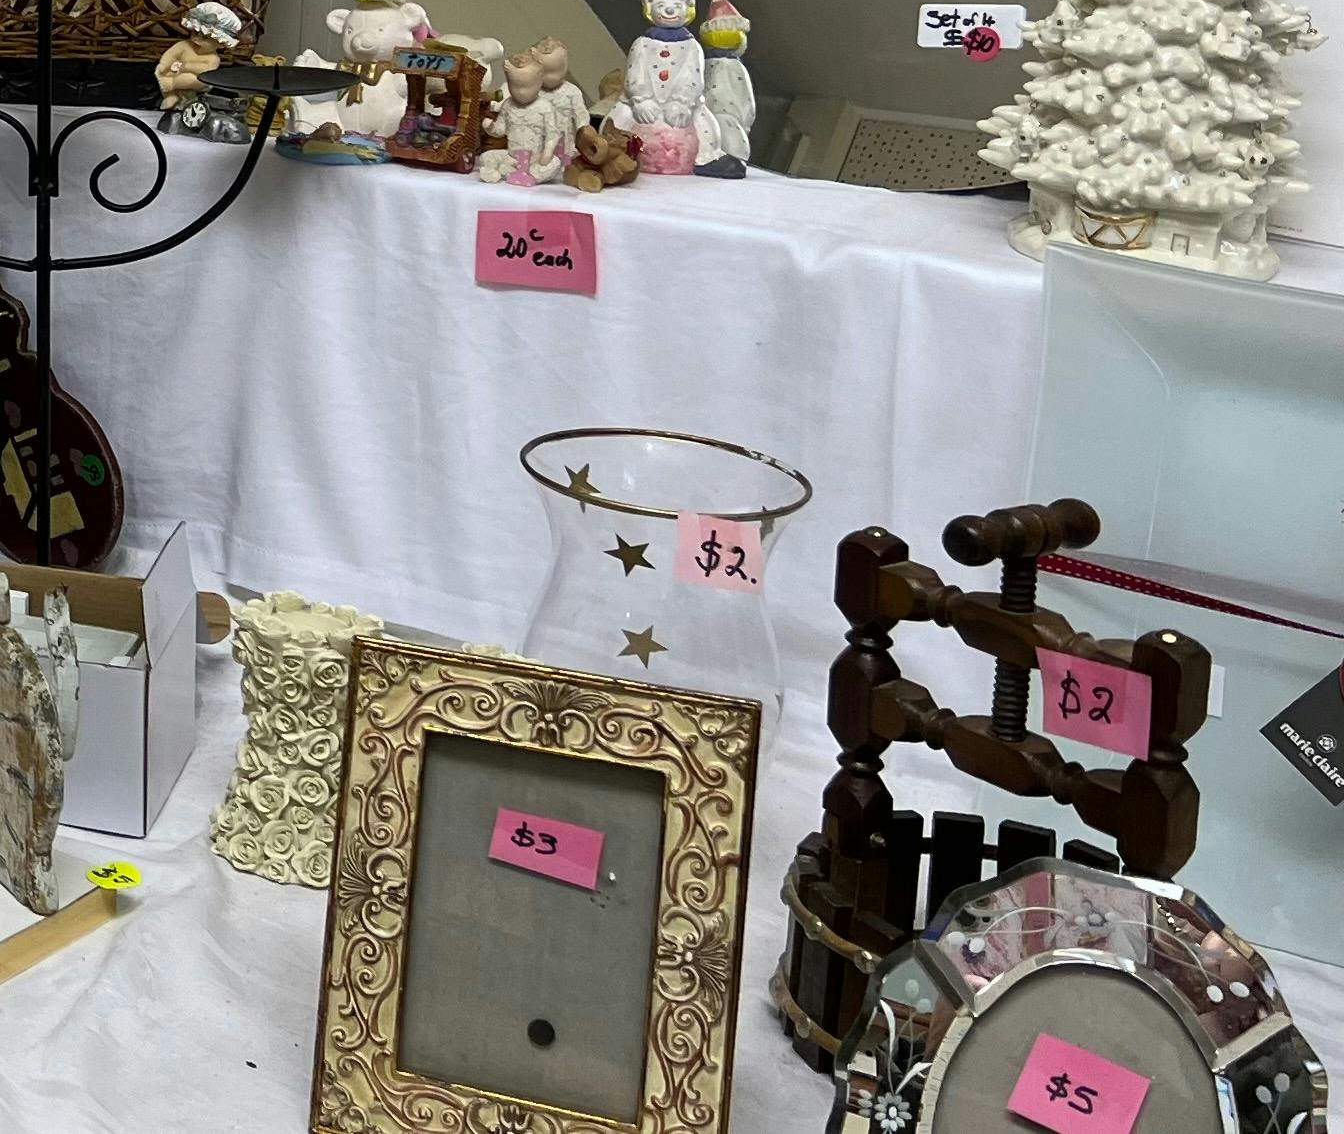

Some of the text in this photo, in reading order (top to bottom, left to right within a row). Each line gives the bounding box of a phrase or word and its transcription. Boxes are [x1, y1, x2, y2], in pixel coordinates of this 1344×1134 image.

[925, 8, 961, 28] Set
[531, 248, 573, 270] each
[1058, 670, 1114, 724] $2
[1279, 722, 1315, 757] marie
[510, 821, 558, 855] $3
[1046, 1073, 1098, 1115] $5
